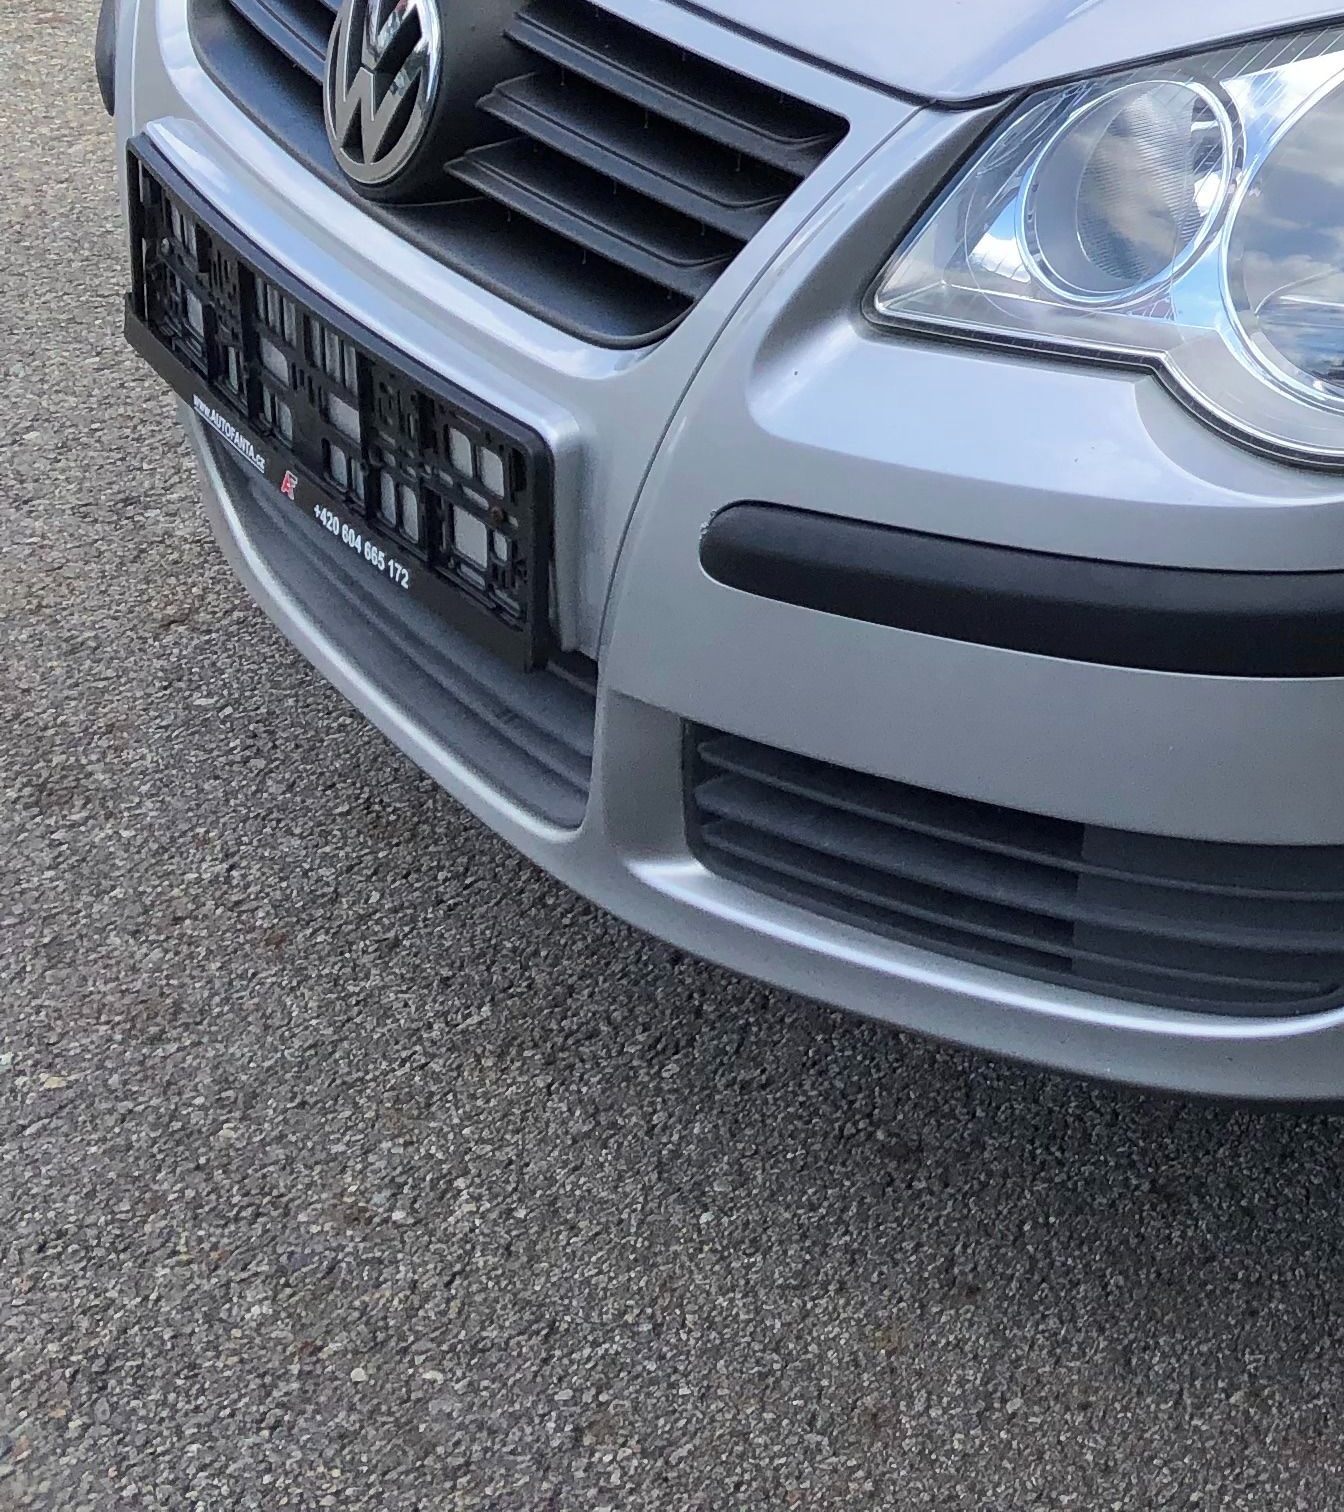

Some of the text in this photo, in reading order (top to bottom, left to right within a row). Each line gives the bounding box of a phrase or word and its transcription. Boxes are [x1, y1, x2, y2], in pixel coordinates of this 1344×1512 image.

[193, 393, 266, 472] www.AUTOFANTA.cz
[313, 504, 409, 589] +420 604 665 172
